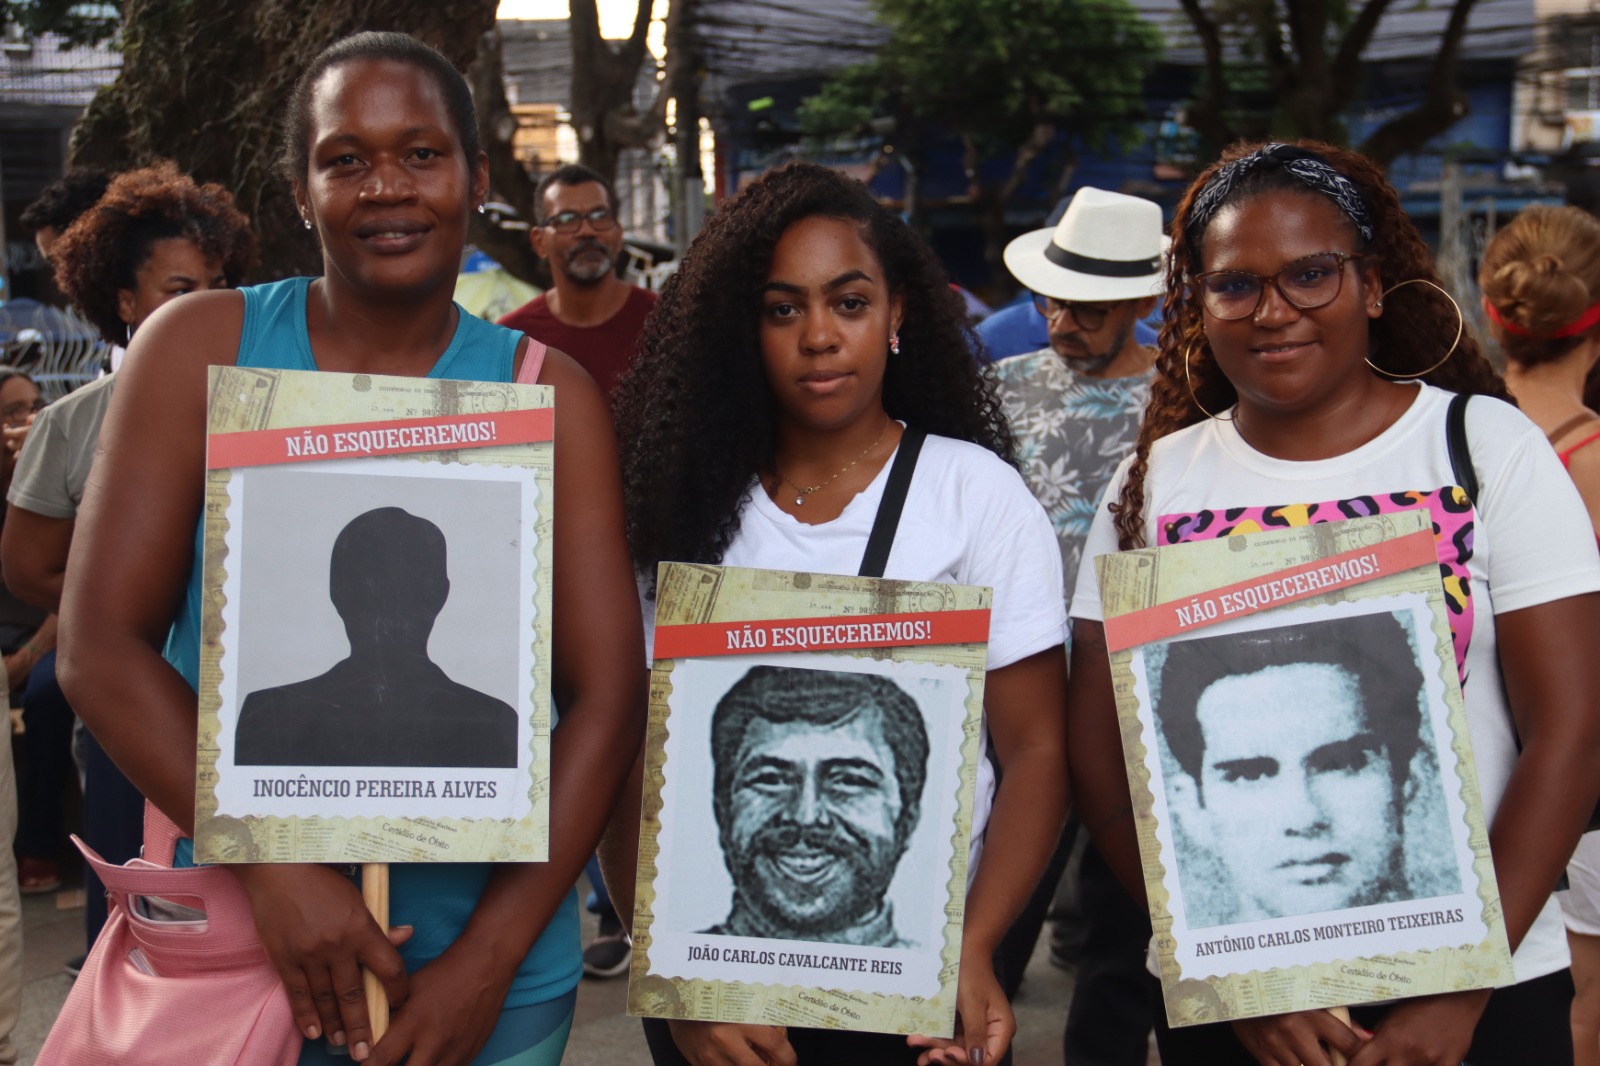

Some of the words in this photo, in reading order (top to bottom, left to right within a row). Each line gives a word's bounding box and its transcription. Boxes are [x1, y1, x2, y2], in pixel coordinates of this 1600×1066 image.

[285, 430, 328, 457] NÃO
[334, 421, 497, 454] ESQUECEREMOS!
[1175, 597, 1218, 628] NÃO
[1219, 553, 1380, 615] ESQUECEREMOS!
[726, 624, 766, 649] NÃO
[772, 620, 932, 649] ESQUECEREMOS!
[253, 774, 350, 798] INOCÊNCIO
[355, 780, 437, 798] PEREIRA
[441, 780, 497, 799] ALVES
[382, 823, 415, 840] Certidão
[416, 833, 427, 843] de
[428, 835, 450, 850] Óbito
[1195, 934, 1256, 958] ANTÔNIO
[1258, 928, 1311, 948] CARLOS
[1313, 919, 1385, 942] MONTEIRO
[1387, 908, 1464, 930] TEIXEIRAS
[687, 944, 720, 962] JOÃO
[723, 948, 776, 966] CARLOS
[778, 952, 867, 973] CAVALCANTE
[870, 960, 903, 976] REIS
[1340, 965, 1375, 979] Certidão
[1376, 970, 1387, 980] de
[1389, 971, 1412, 985] Óbito
[798, 991, 830, 1010] Certidão
[830, 1002, 840, 1012] de
[840, 1004, 861, 1021] Óbito
